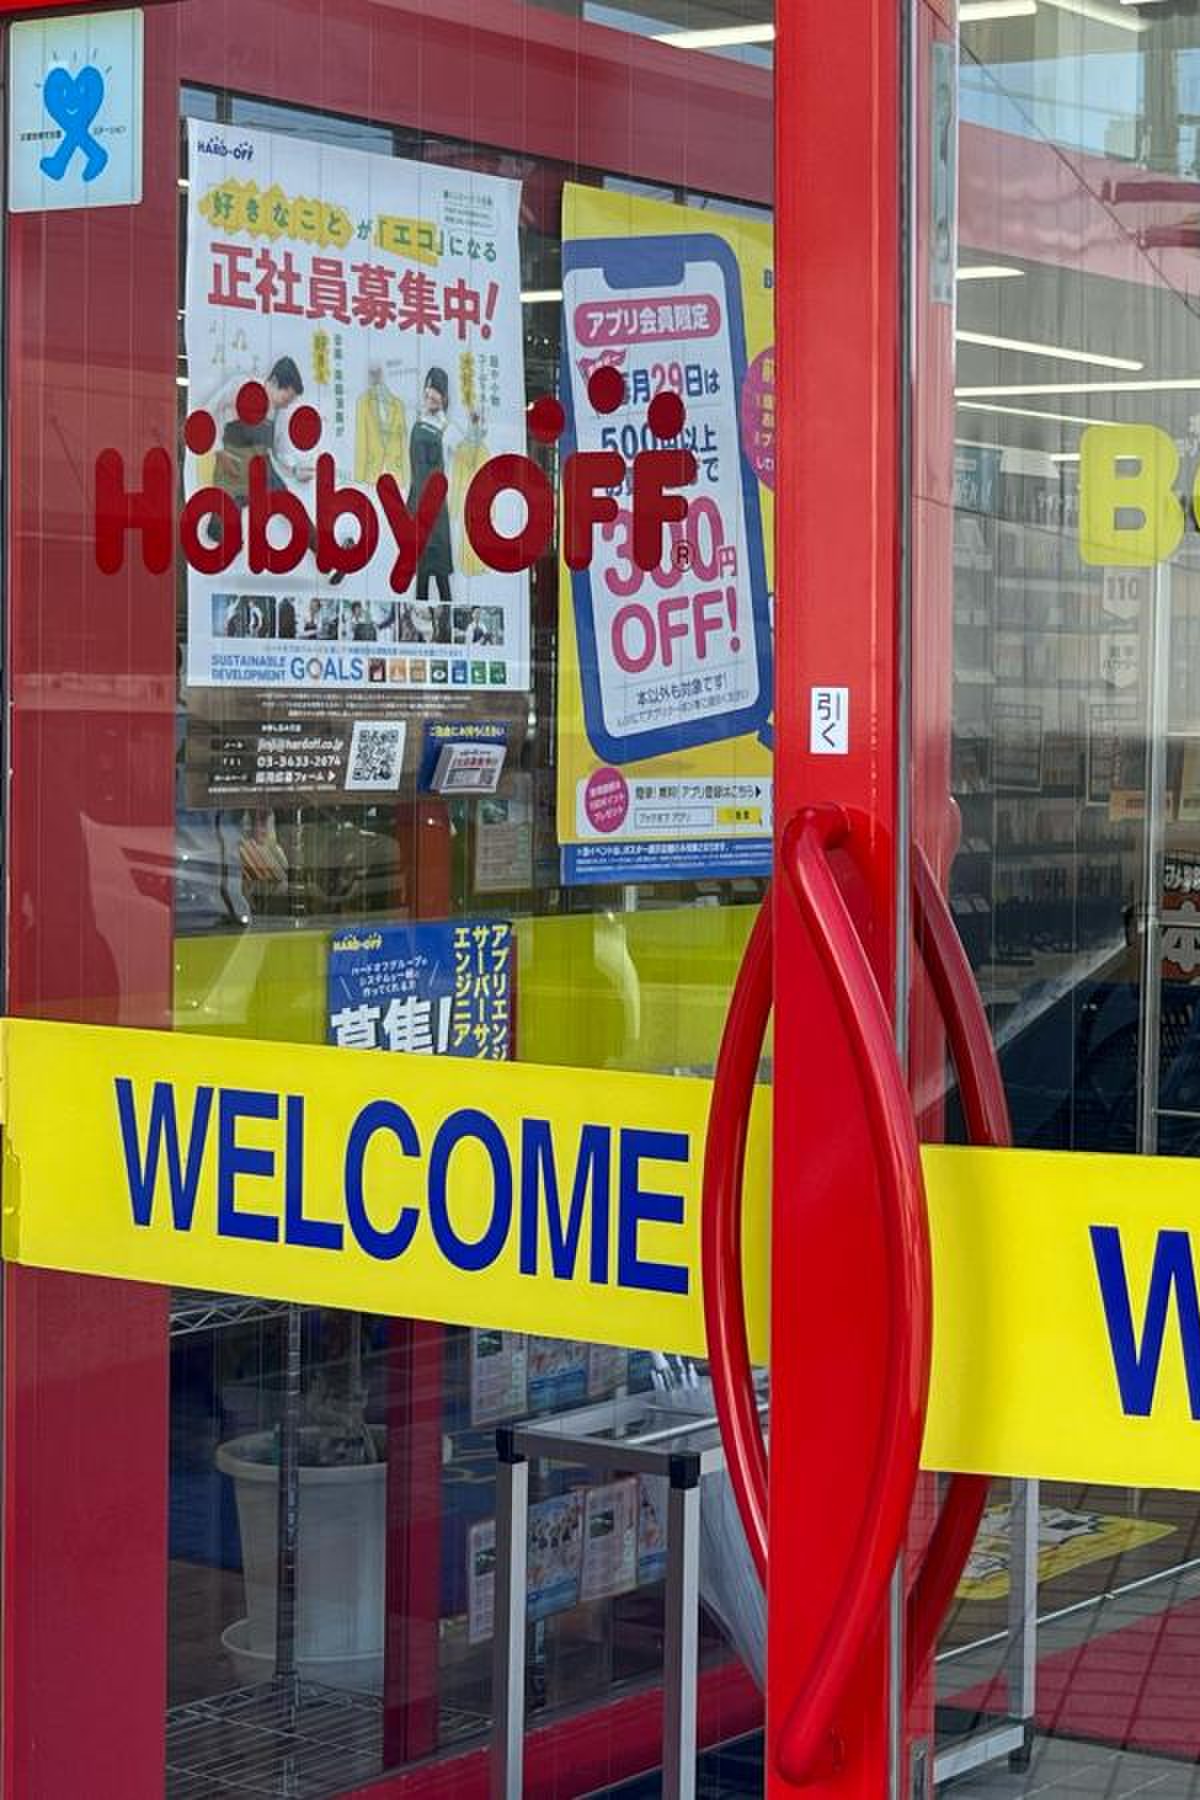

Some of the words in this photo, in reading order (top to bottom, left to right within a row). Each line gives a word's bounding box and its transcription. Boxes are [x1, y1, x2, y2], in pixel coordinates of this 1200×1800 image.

[207, 242, 499, 341] 正社員募集中!
[586, 303, 709, 338] アプリ会員限定
[95, 446, 448, 595] Hobby
[464, 451, 699, 575] OFF
[290, 657, 364, 682] GOALS
[611, 586, 741, 675] OFF!
[817, 691, 843, 749] 引く
[453, 927, 472, 1047] エンジニア
[114, 1077, 690, 1295] WELCOME
